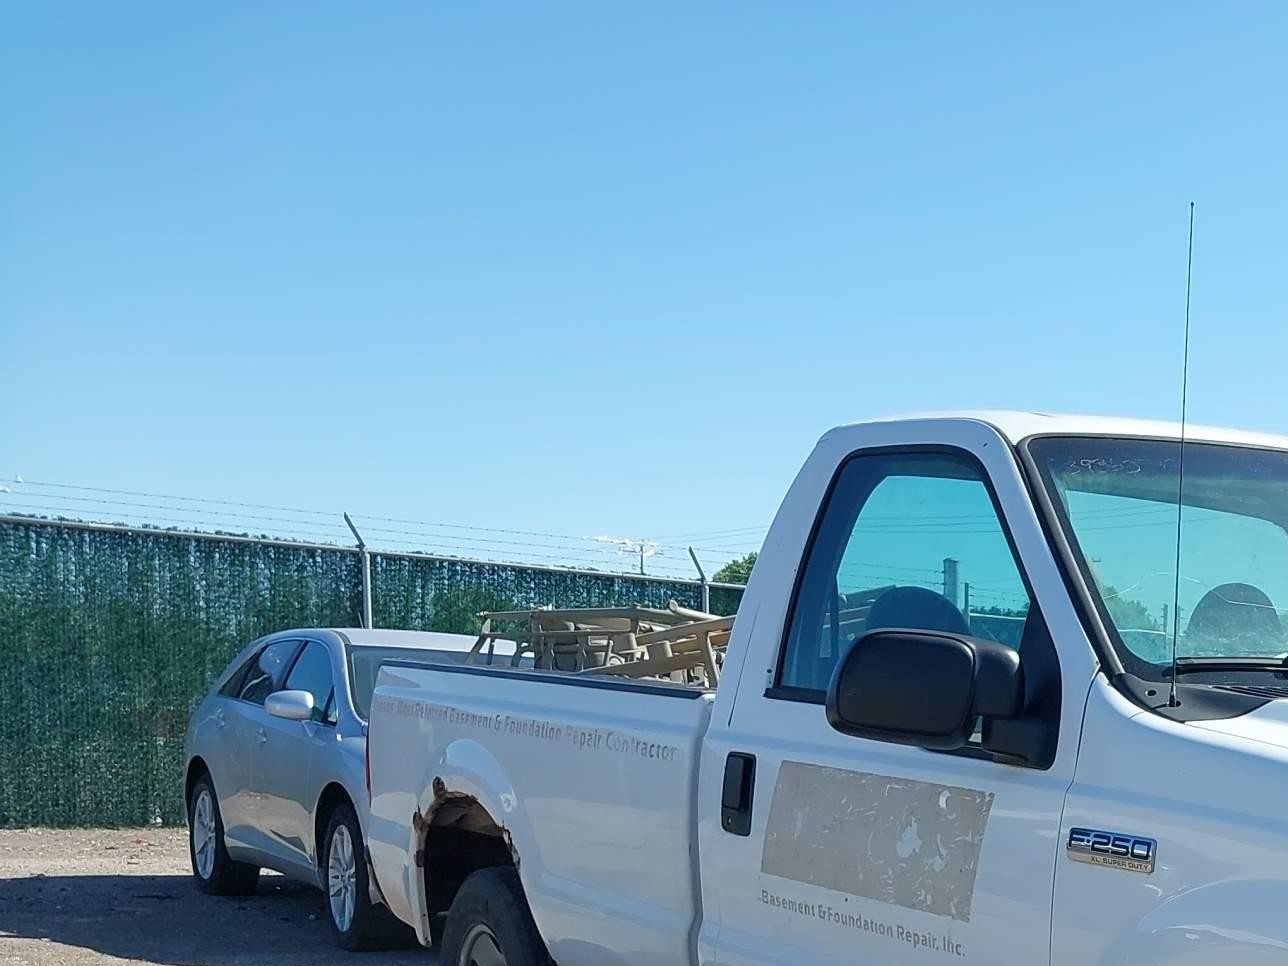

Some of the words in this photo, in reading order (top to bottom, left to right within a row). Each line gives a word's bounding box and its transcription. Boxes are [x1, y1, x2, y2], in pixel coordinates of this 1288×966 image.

[449, 708, 493, 729] Basement
[493, 714, 502, 731] &
[505, 715, 562, 742] Foundation
[565, 724, 602, 750] Repair
[606, 730, 678, 761] Contractor
[762, 889, 816, 919] Basement
[943, 936, 966, 957] Inc.
